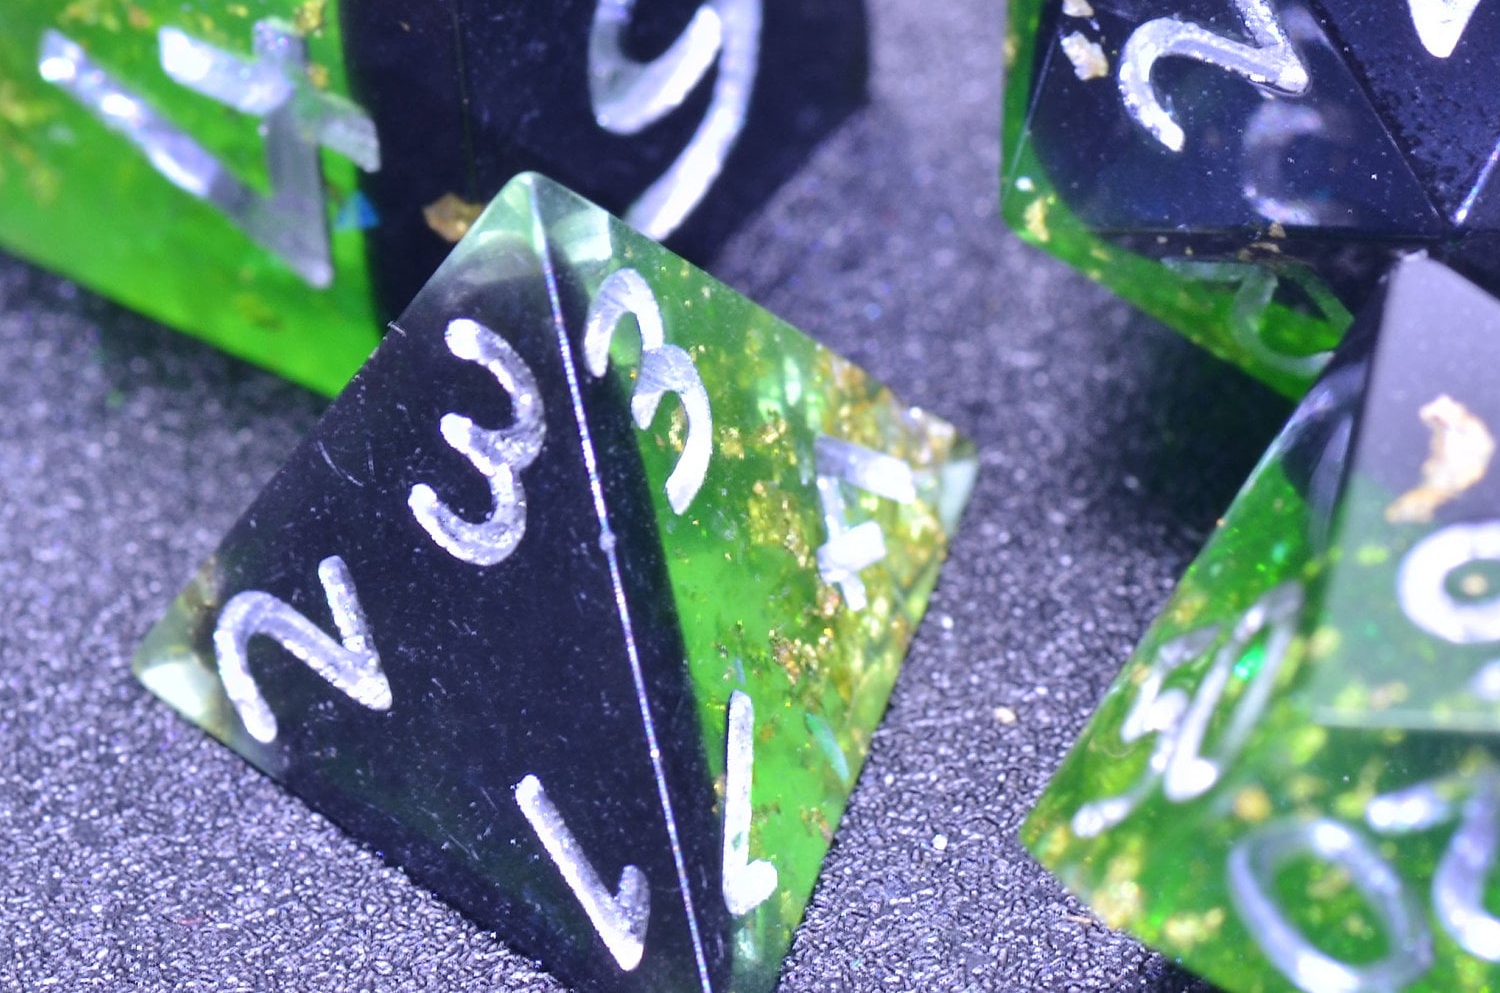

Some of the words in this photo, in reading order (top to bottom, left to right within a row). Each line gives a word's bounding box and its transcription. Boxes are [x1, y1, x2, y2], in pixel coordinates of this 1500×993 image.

[38, 16, 381, 288] 4
[407, 318, 545, 566] 3
[585, 267, 712, 515] 3
[214, 555, 393, 743] 2
[515, 773, 649, 972] 1
[723, 689, 778, 915] 1
